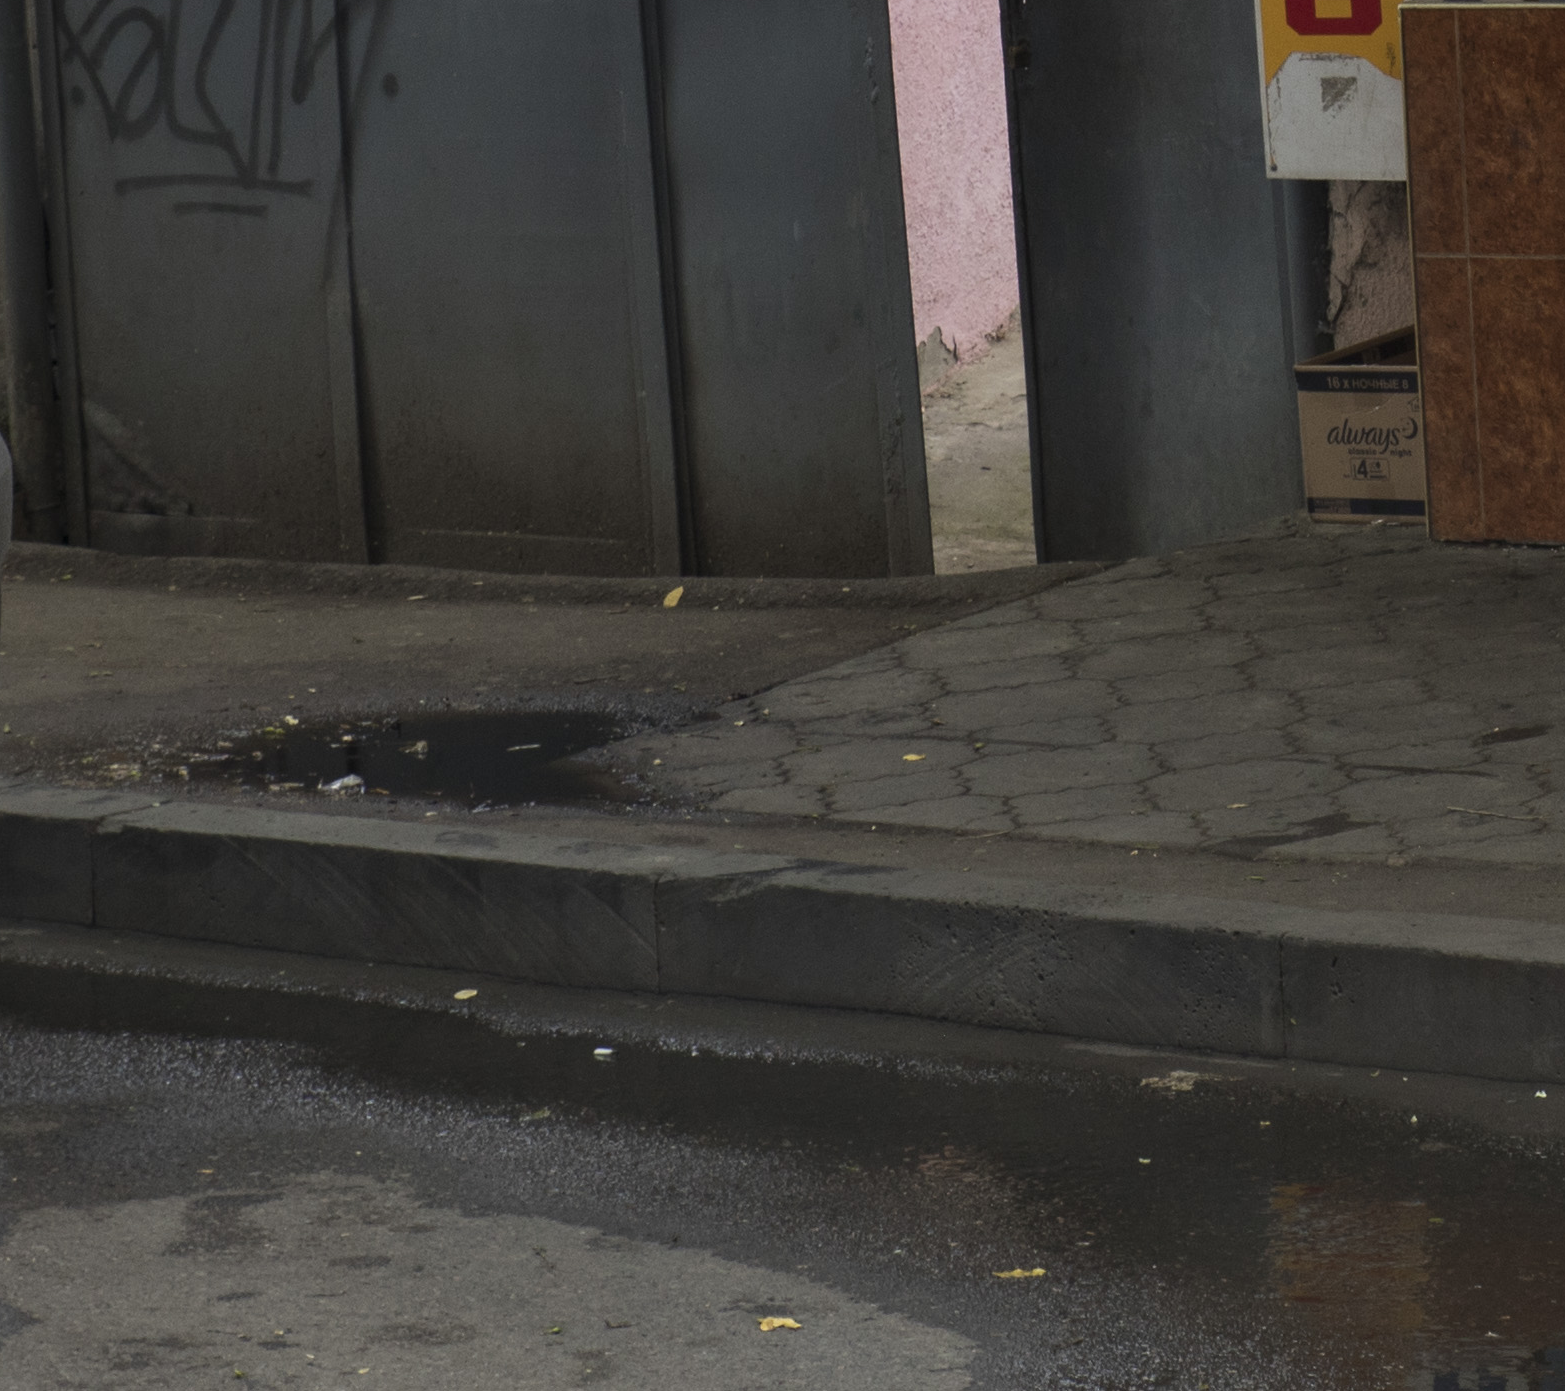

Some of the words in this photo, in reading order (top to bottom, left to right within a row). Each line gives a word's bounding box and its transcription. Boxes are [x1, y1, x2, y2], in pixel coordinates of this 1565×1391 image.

[1352, 378, 1399, 390] НОЧНЫЕ
[1327, 418, 1401, 455] always
[1348, 447, 1377, 457] classic
[1390, 448, 1412, 459] night
